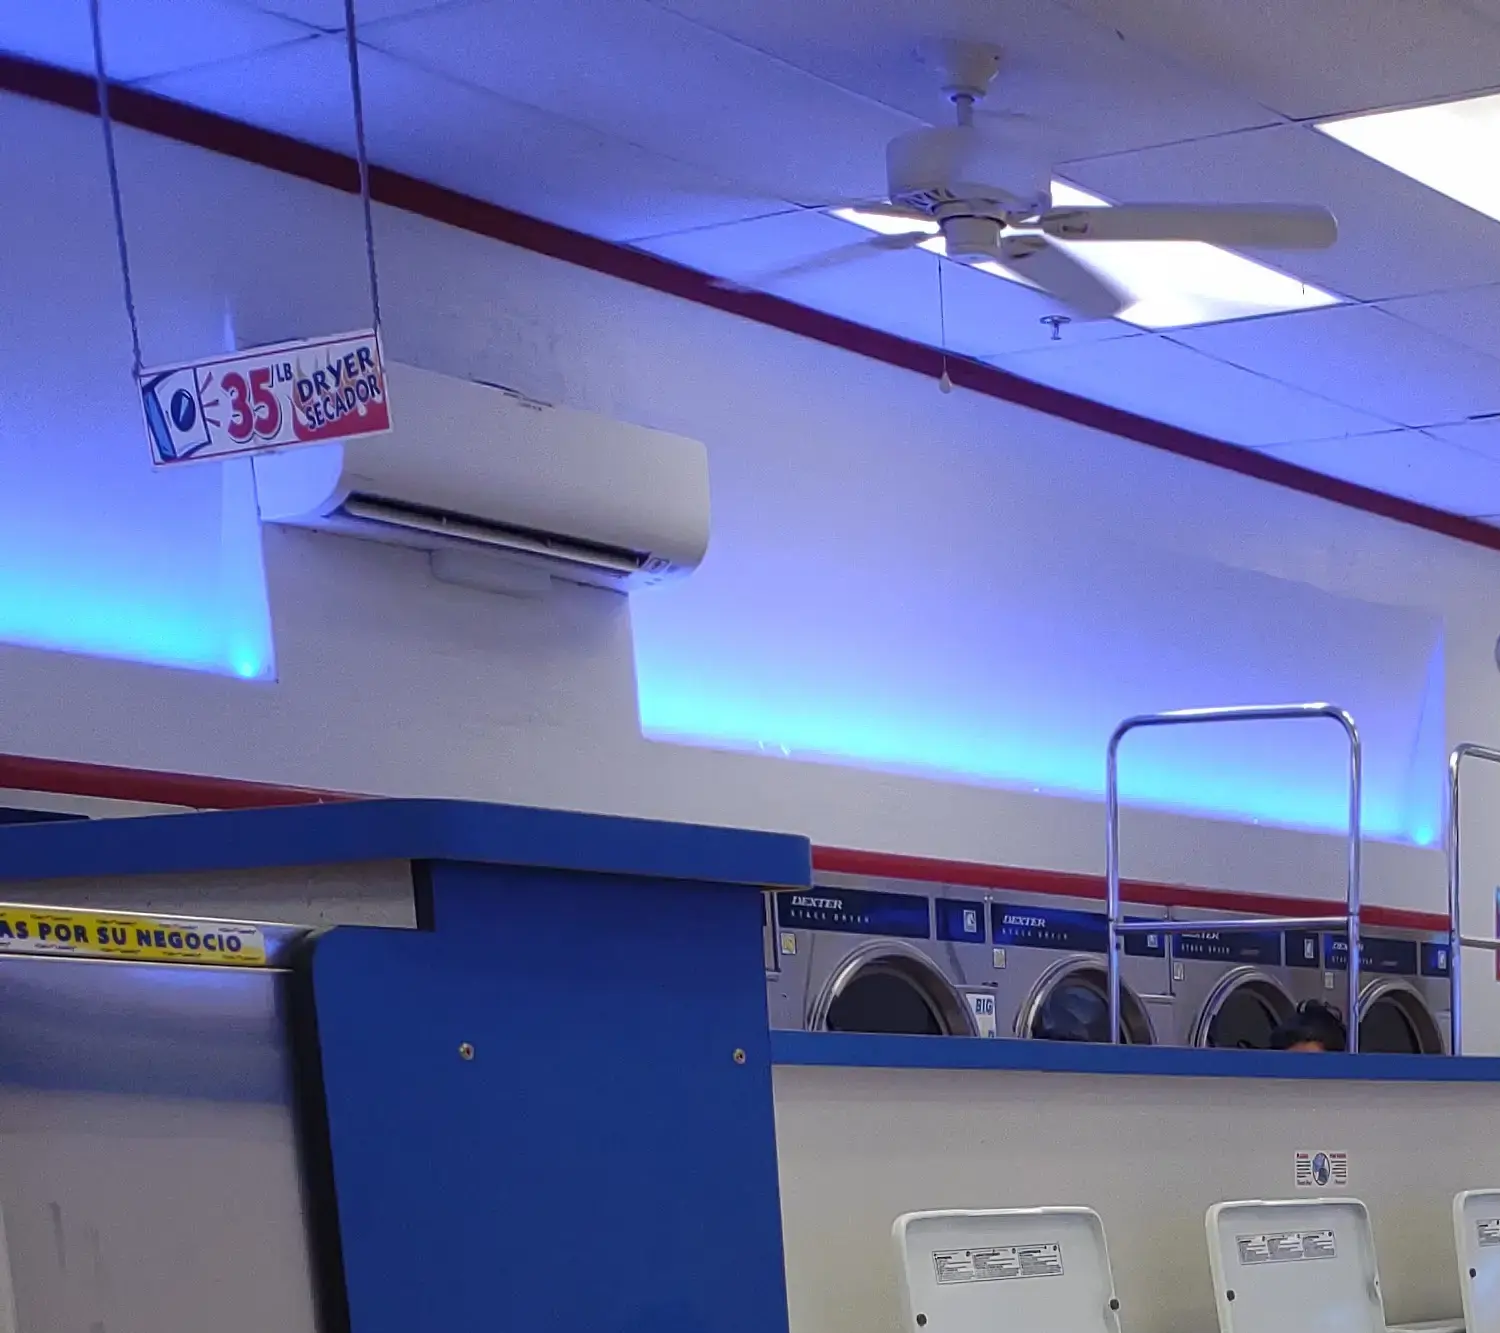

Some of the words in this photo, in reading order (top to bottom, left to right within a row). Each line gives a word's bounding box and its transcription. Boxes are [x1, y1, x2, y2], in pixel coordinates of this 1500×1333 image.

[296, 346, 375, 403] DRYER
[304, 374, 381, 430] SECADOR
[791, 895, 844, 910] DEXTER
[1002, 915, 1047, 928] DEXTER
[37, 921, 90, 944] POR
[96, 925, 127, 946] SU
[135, 928, 243, 953] NEGOCIO
[975, 998, 994, 1014] BIG
